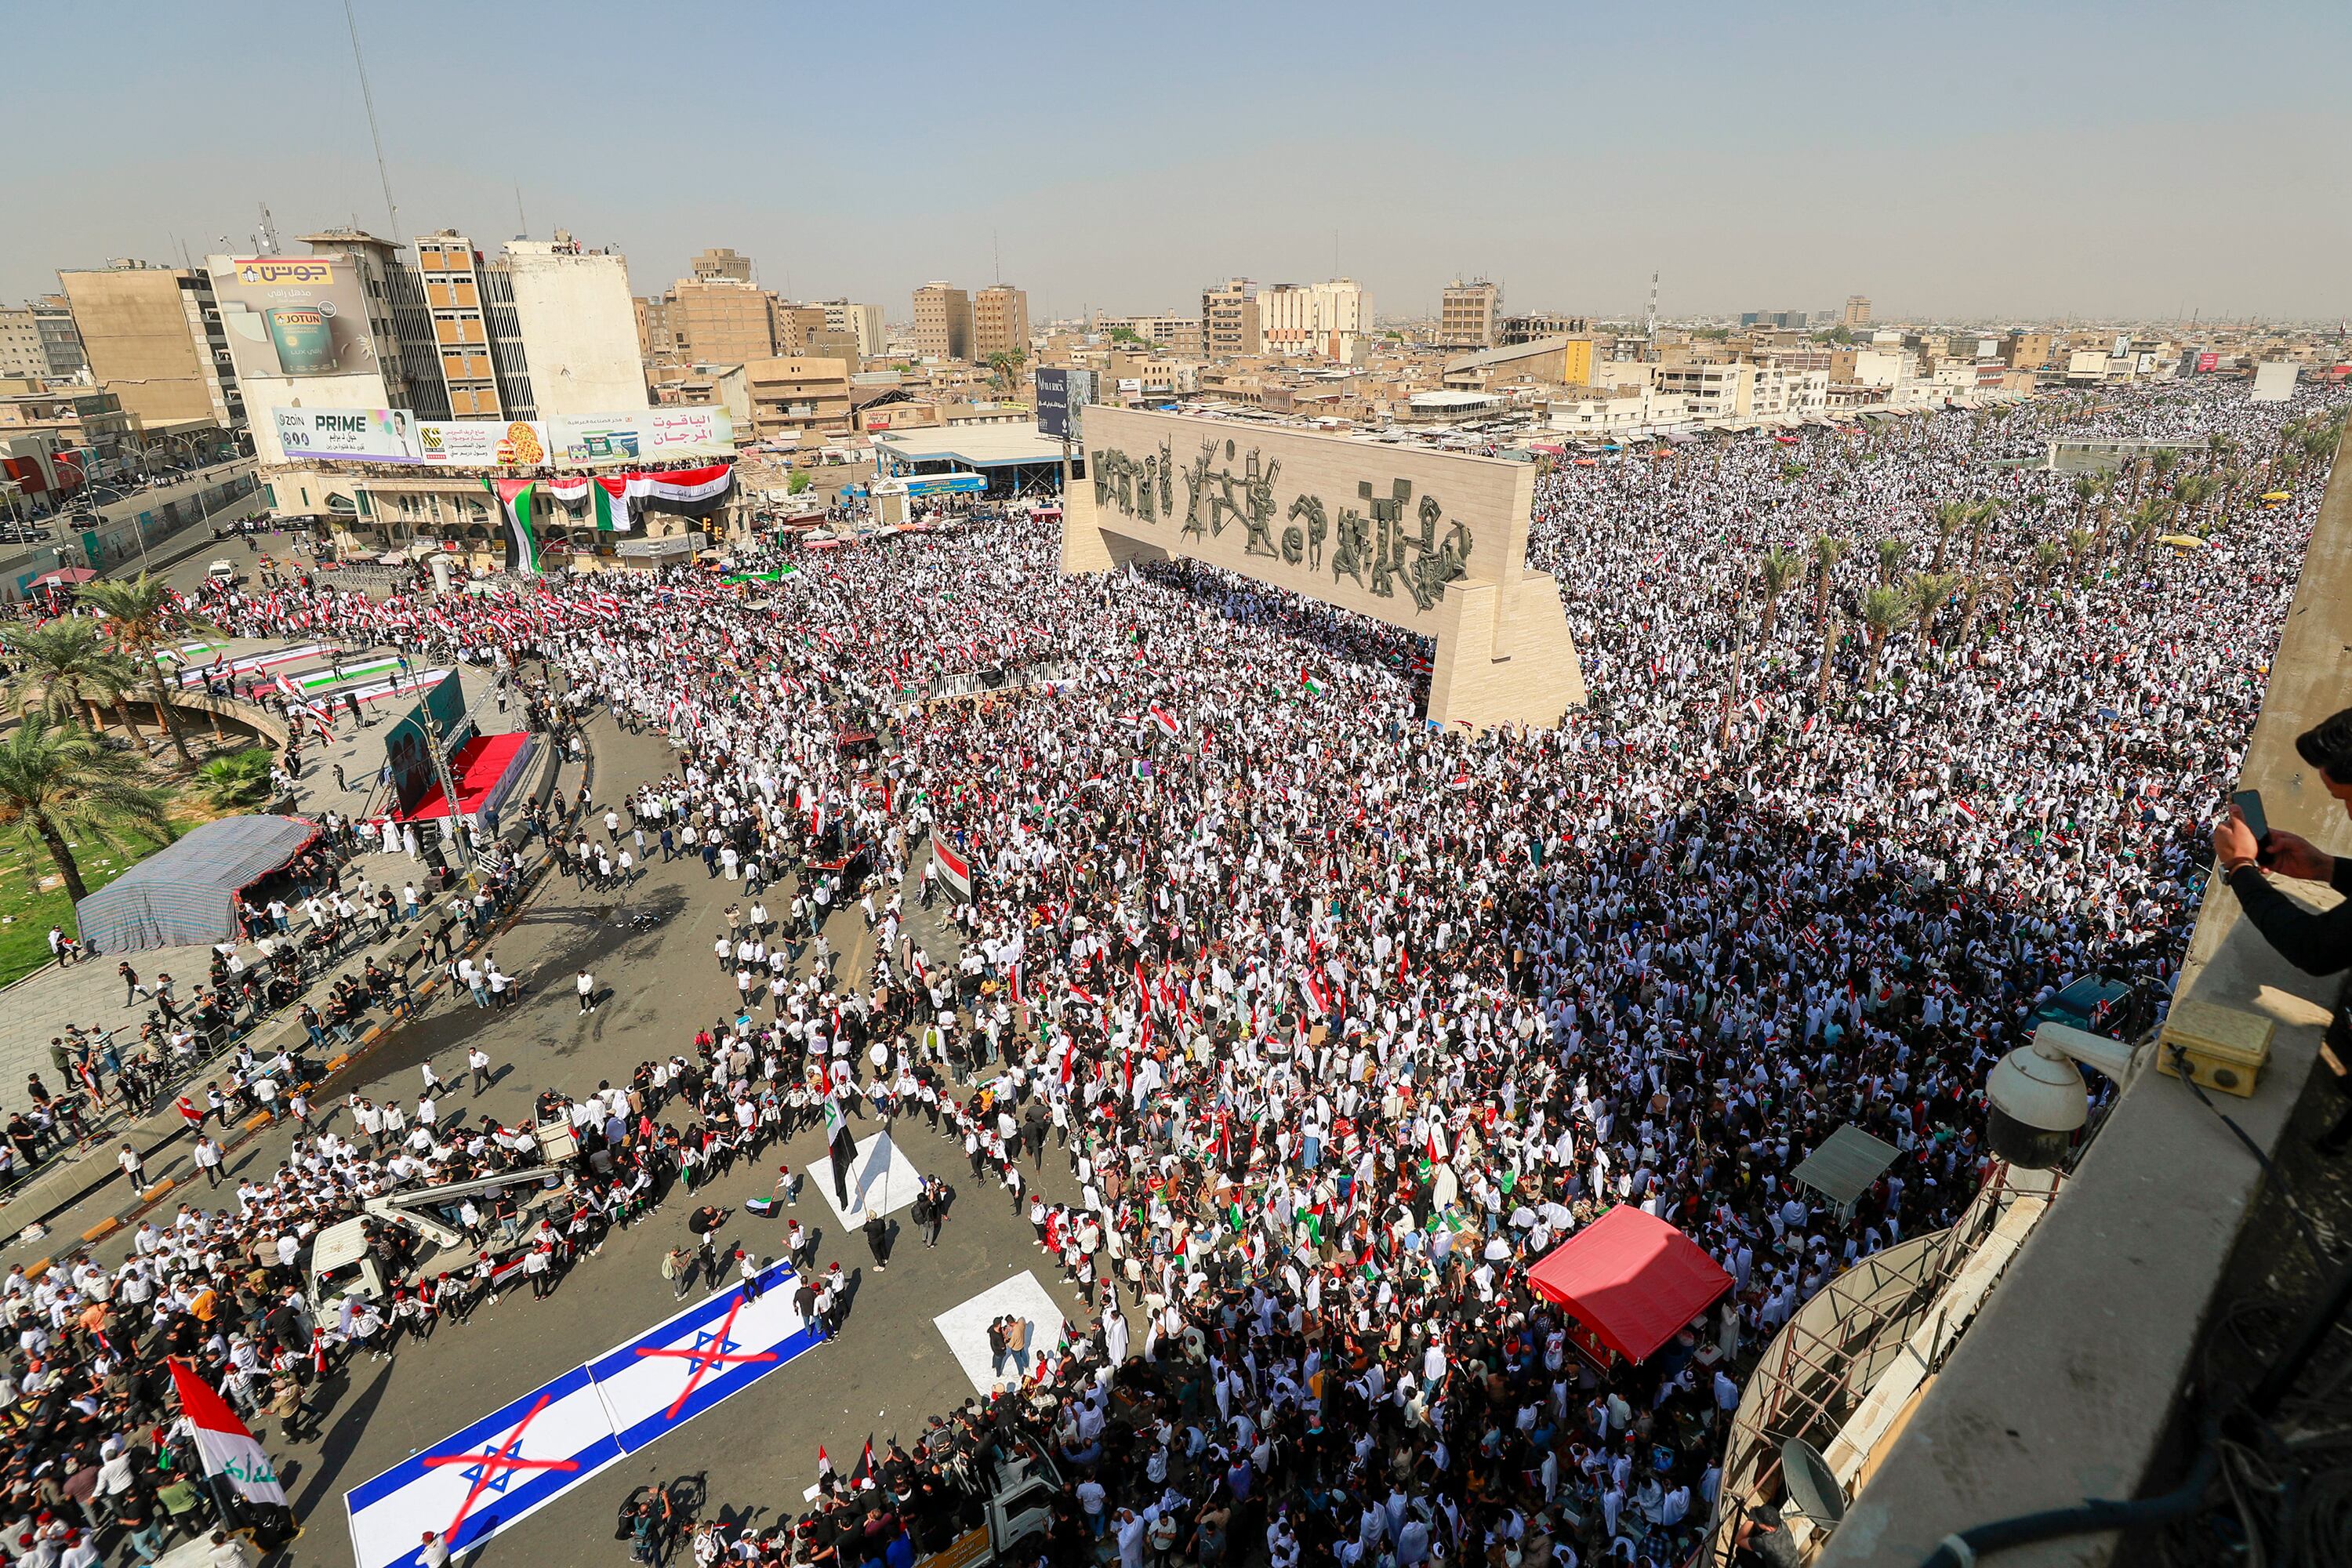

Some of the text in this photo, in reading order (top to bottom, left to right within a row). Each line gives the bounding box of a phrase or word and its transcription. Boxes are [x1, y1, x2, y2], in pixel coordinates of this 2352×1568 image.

[260, 265, 327, 281] جوتن
[287, 315, 320, 324] JOTUN
[653, 415, 710, 429] الياقوت
[654, 429, 713, 445] المرجان
